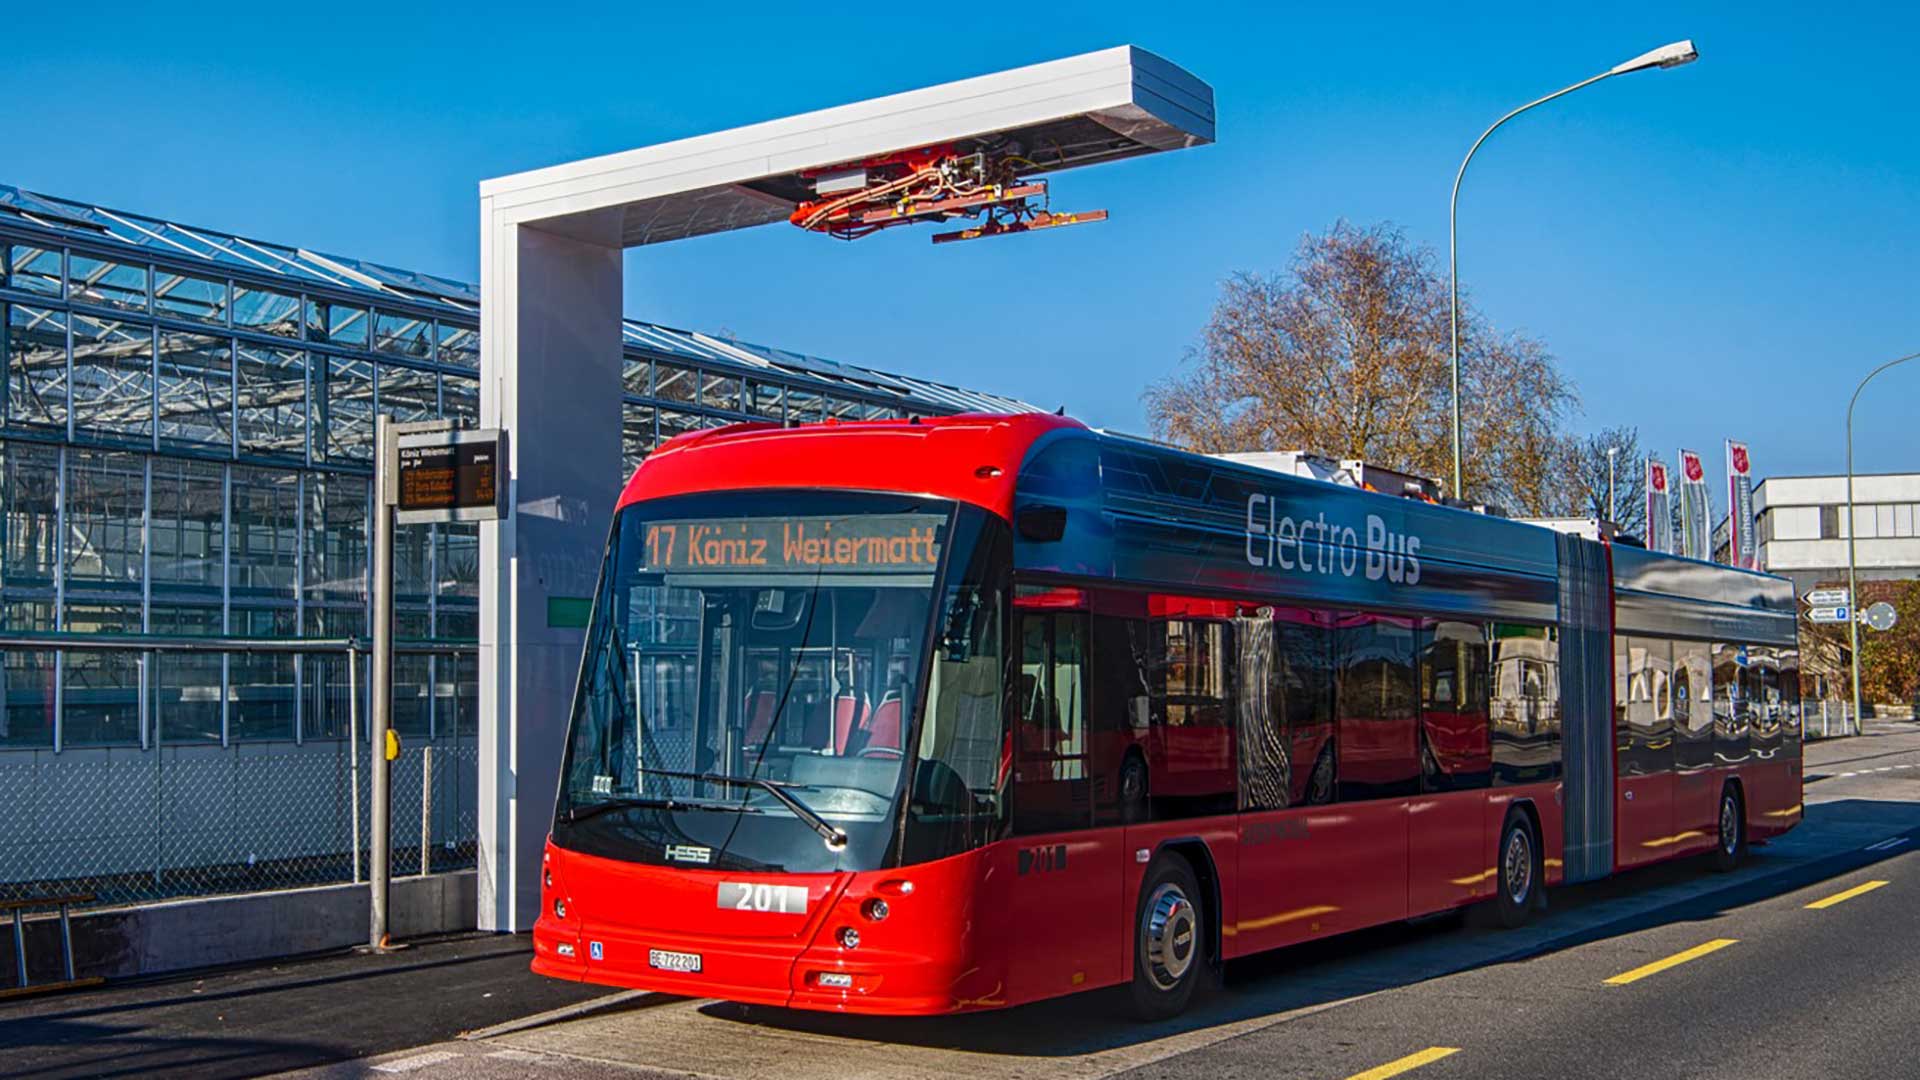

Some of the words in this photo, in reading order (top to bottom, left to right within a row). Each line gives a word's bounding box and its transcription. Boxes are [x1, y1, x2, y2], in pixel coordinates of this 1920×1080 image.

[646, 524, 677, 566] 17
[688, 523, 767, 565] Köniz
[783, 522, 937, 565] Weiermatt
[1246, 493, 1358, 577] Electro
[1366, 514, 1420, 585] Bus
[665, 844, 711, 864] HESS
[736, 883, 788, 913] 201
